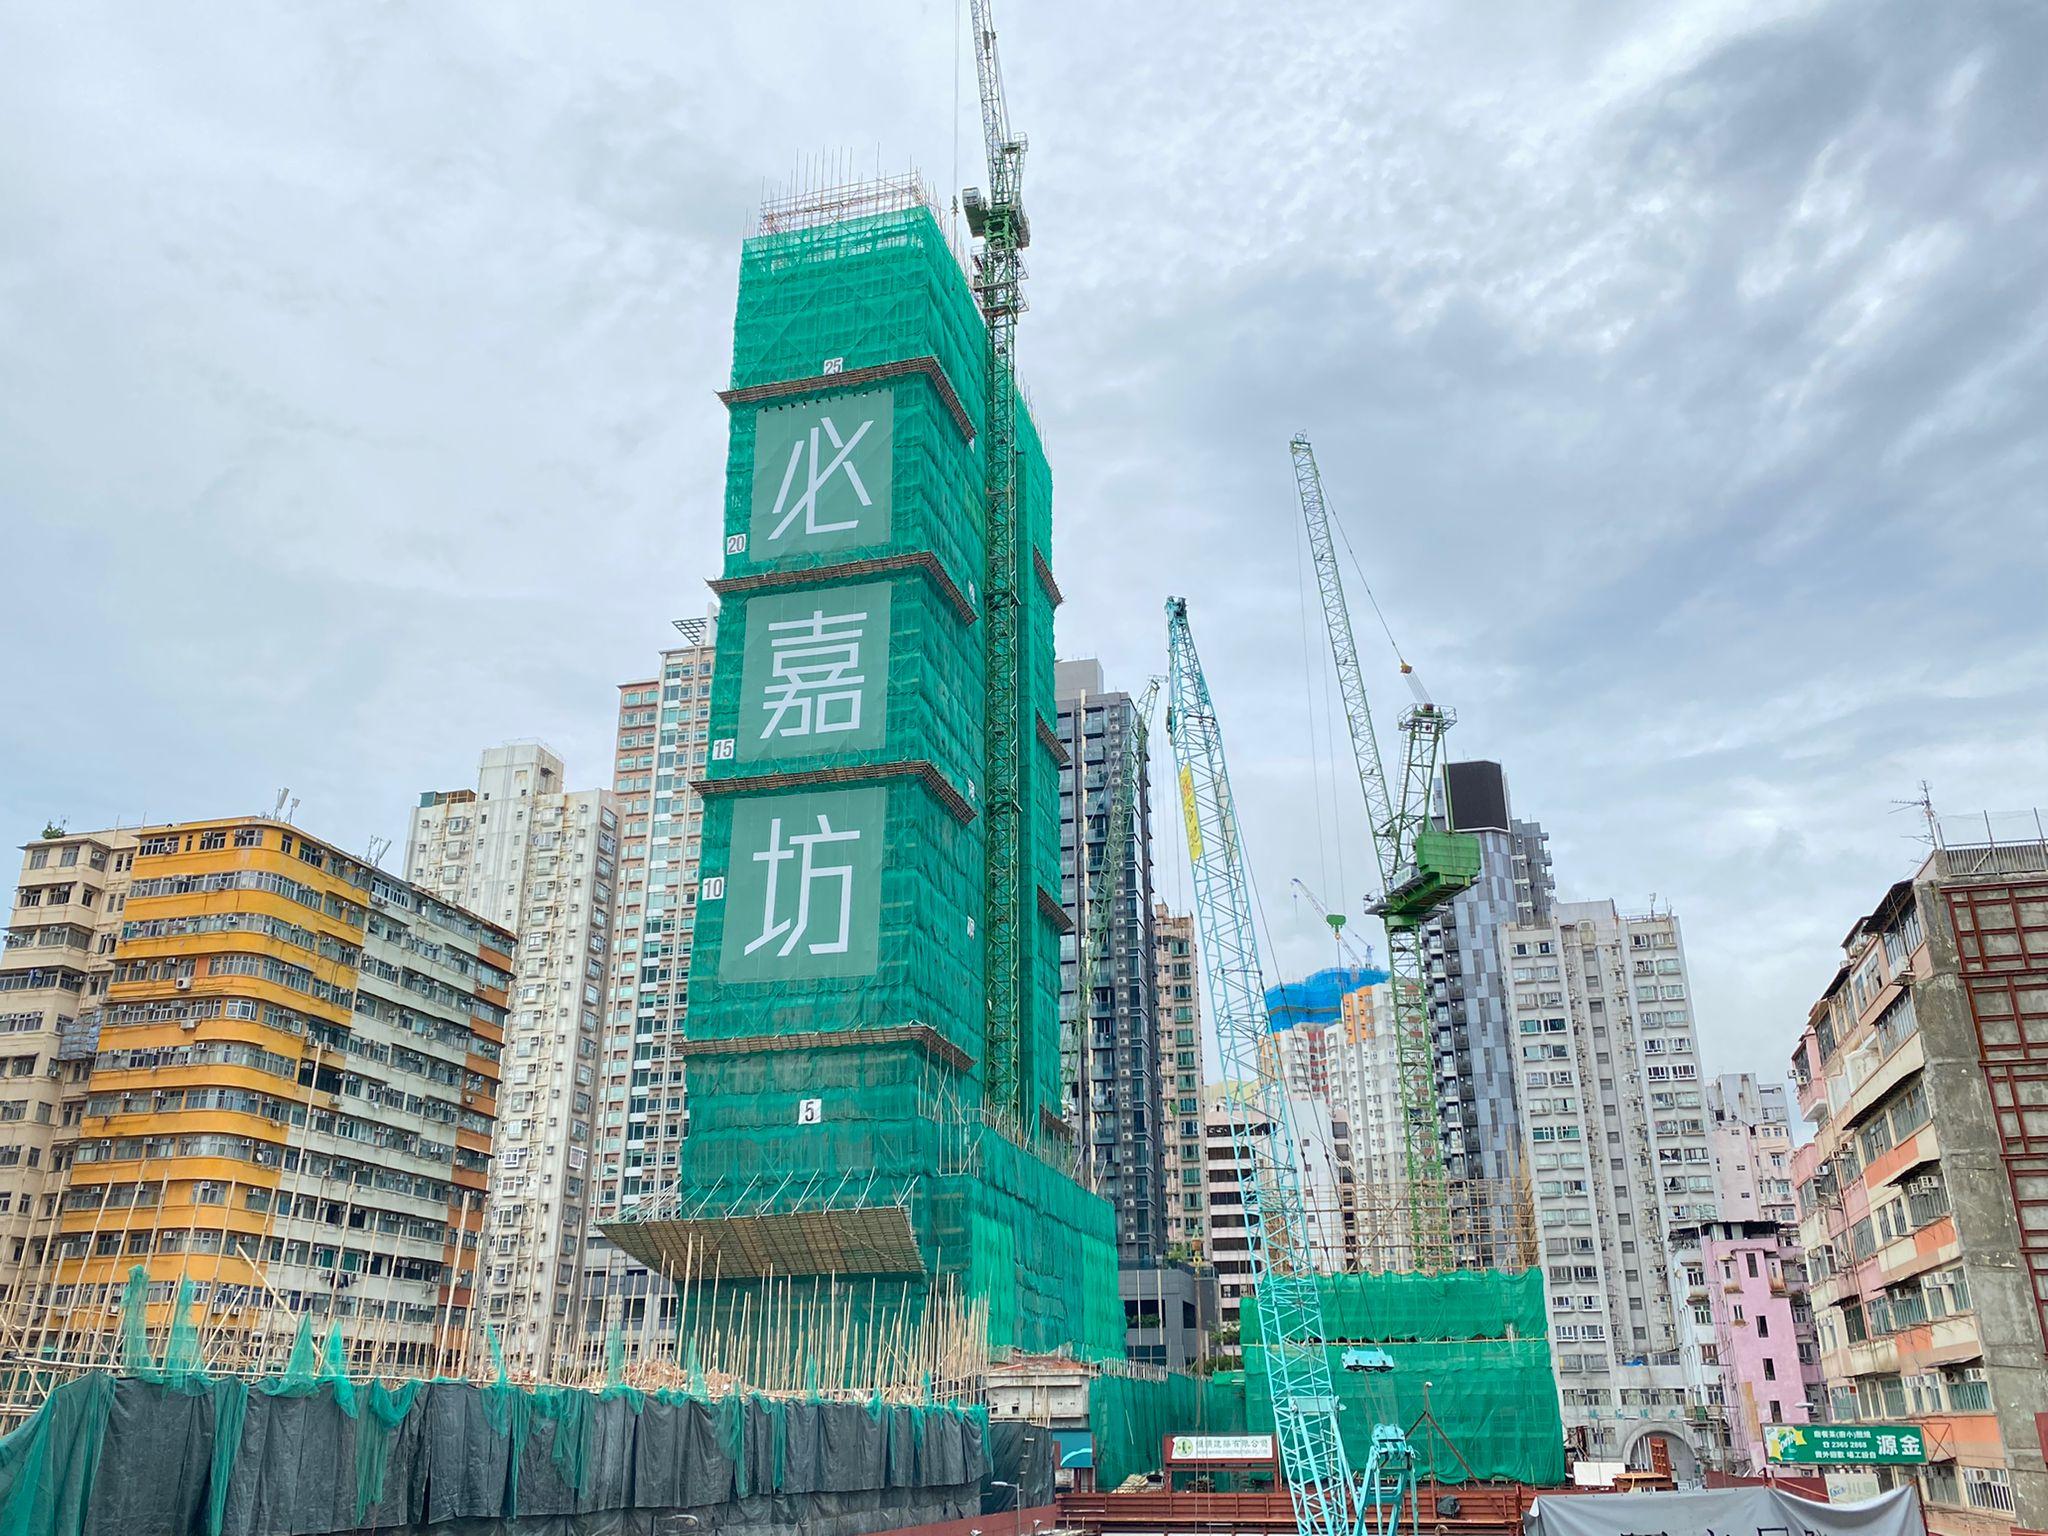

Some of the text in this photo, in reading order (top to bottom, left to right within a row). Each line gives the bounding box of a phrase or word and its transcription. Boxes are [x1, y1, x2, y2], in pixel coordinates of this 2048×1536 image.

[826, 359, 841, 373] 25
[728, 536, 745, 552] 20
[714, 740, 732, 758] 15
[704, 878, 722, 898] 10
[805, 1102, 815, 1121] 5
